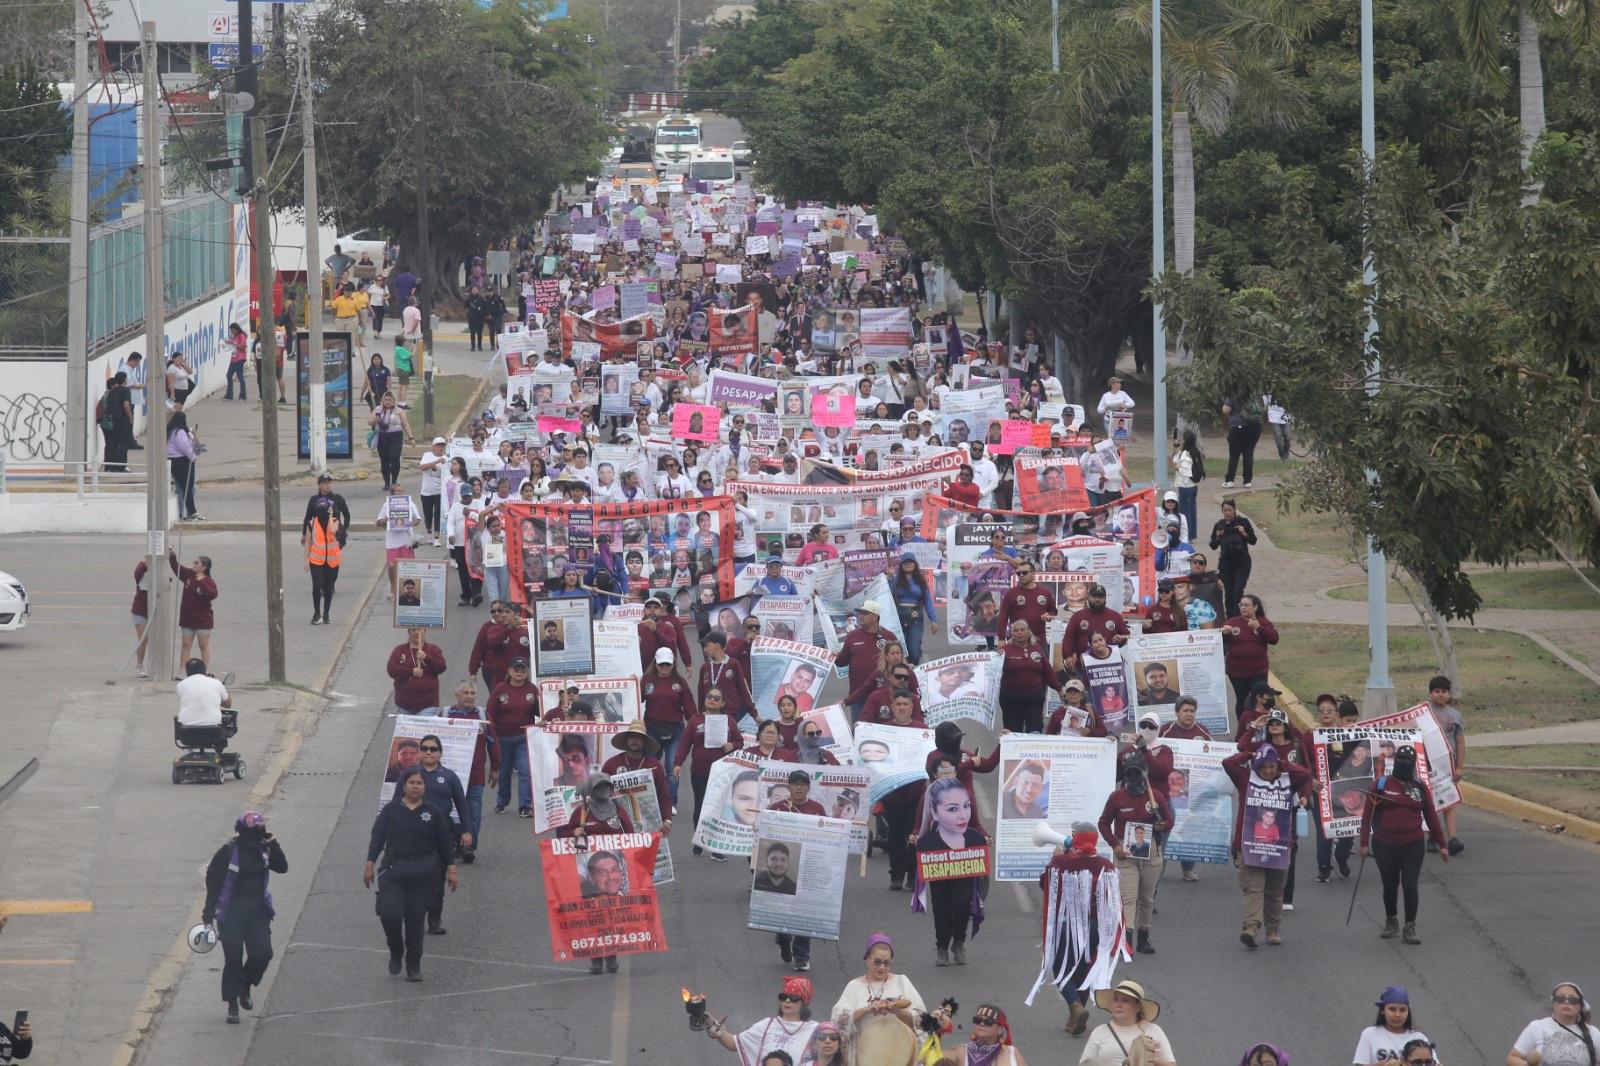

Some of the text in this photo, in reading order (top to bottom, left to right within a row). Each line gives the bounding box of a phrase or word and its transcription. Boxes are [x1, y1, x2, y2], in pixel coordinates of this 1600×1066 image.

[863, 454, 964, 480] DESAPARECIDO
[1021, 457, 1079, 470] DESAPARECIDO
[729, 484, 759, 495] HASTA
[762, 485, 833, 495] ENCONTRARLOS
[529, 500, 703, 516] DESARECIDOS
[746, 566, 804, 578] DESAECIDO
[759, 600, 804, 610] DESAPARECIDO
[755, 636, 836, 662] DESAPARECIDO
[548, 681, 629, 690] DEPARECIDO
[1365, 708, 1425, 728] SAPARECIDO
[1327, 732, 1411, 743] SIN JUSTICIA
[1316, 747, 1331, 818] DESAPARECIDO
[1247, 796, 1290, 811] RESPONSABLE
[551, 832, 653, 856] DESAPARECIDO
[921, 848, 985, 864] Griset Gamboa
[922, 858, 986, 879] DESAPARECIDA
[571, 931, 651, 949] 6671571930
